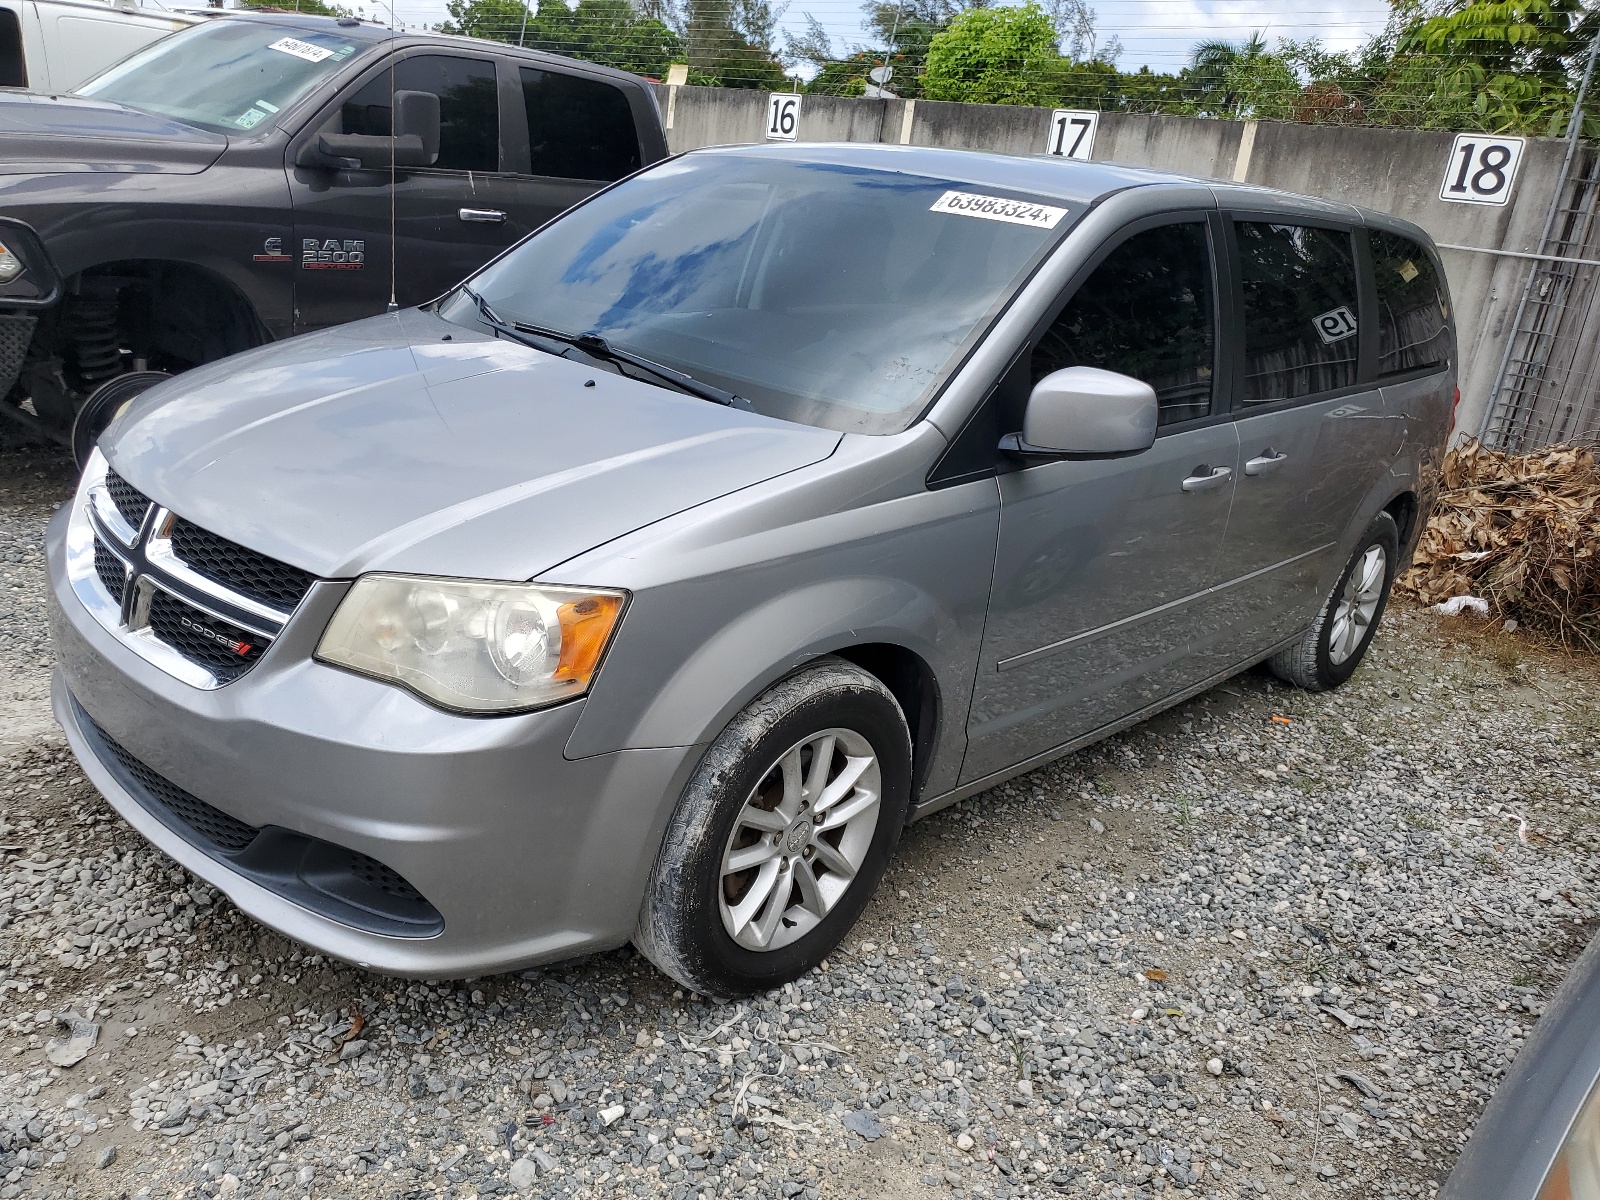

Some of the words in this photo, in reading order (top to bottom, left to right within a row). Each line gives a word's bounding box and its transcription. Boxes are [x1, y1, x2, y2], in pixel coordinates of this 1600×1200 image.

[770, 99, 796, 134] 16
[1052, 117, 1092, 157] 17
[1449, 143, 1511, 195] 18
[303, 238, 364, 251] RAM
[303, 251, 364, 262] 2500
[181, 616, 240, 651] DODGE
